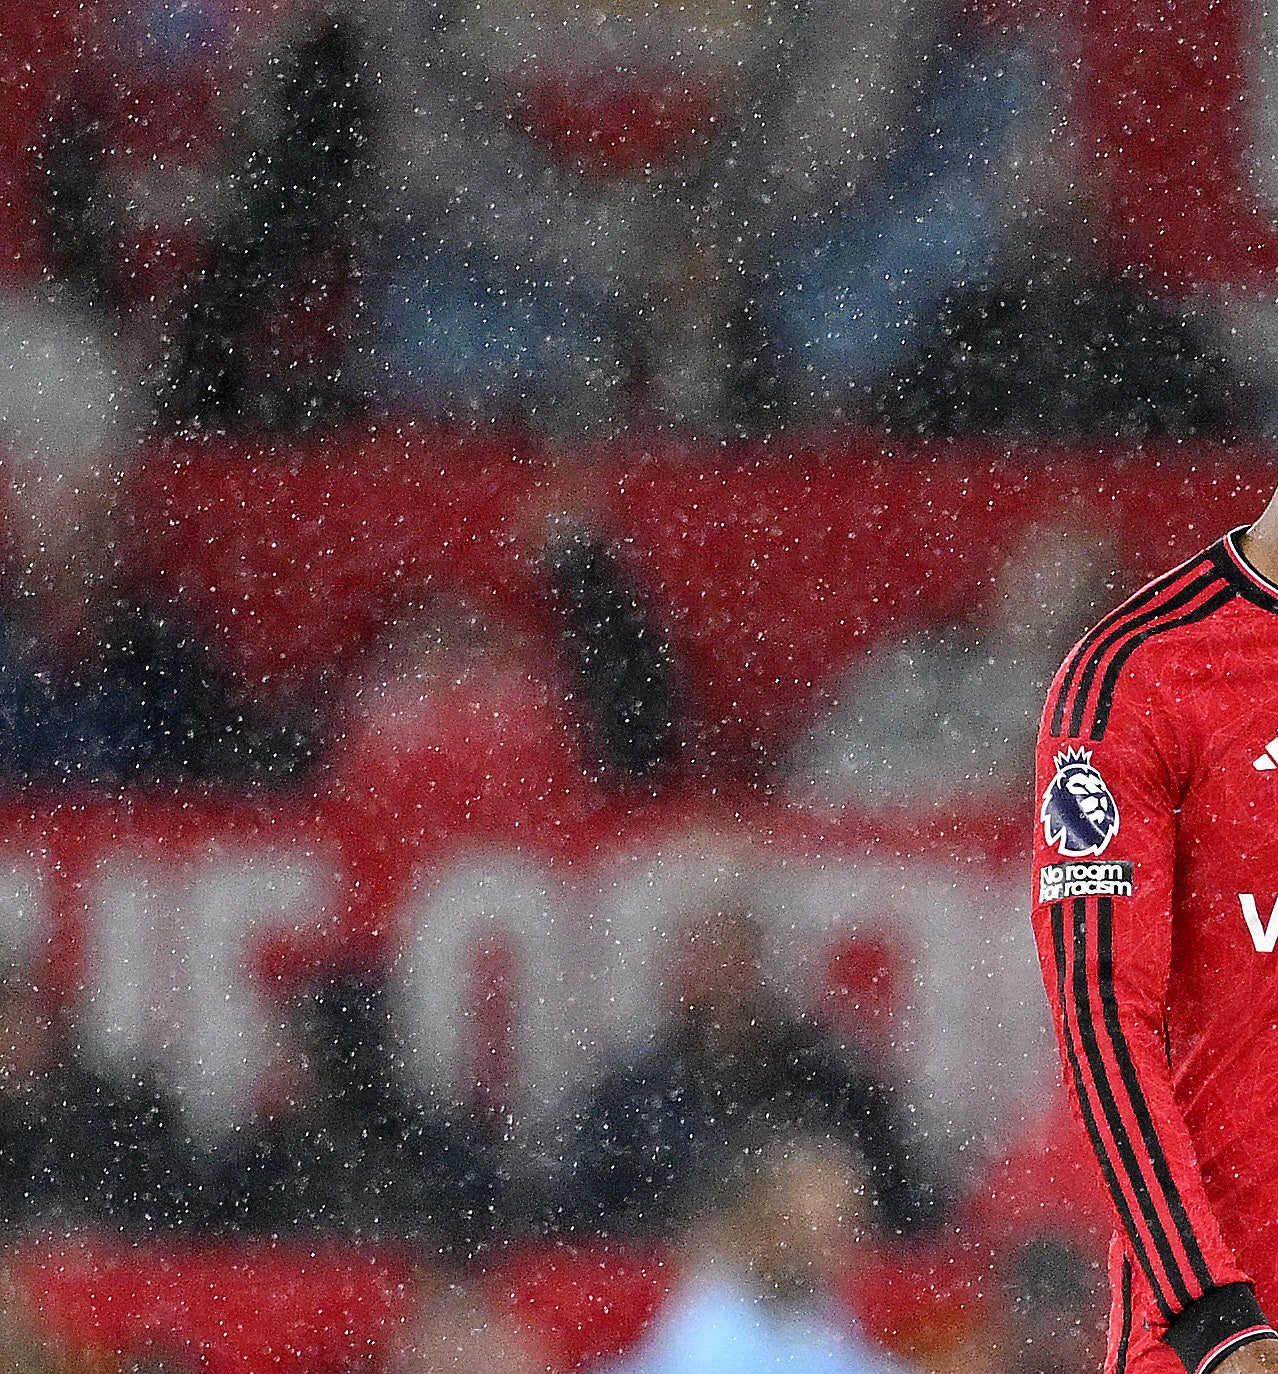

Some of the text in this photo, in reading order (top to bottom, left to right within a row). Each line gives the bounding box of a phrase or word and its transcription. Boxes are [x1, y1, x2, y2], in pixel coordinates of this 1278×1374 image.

[1040, 864, 1123, 886] No room
[1064, 880, 1132, 897] racism
